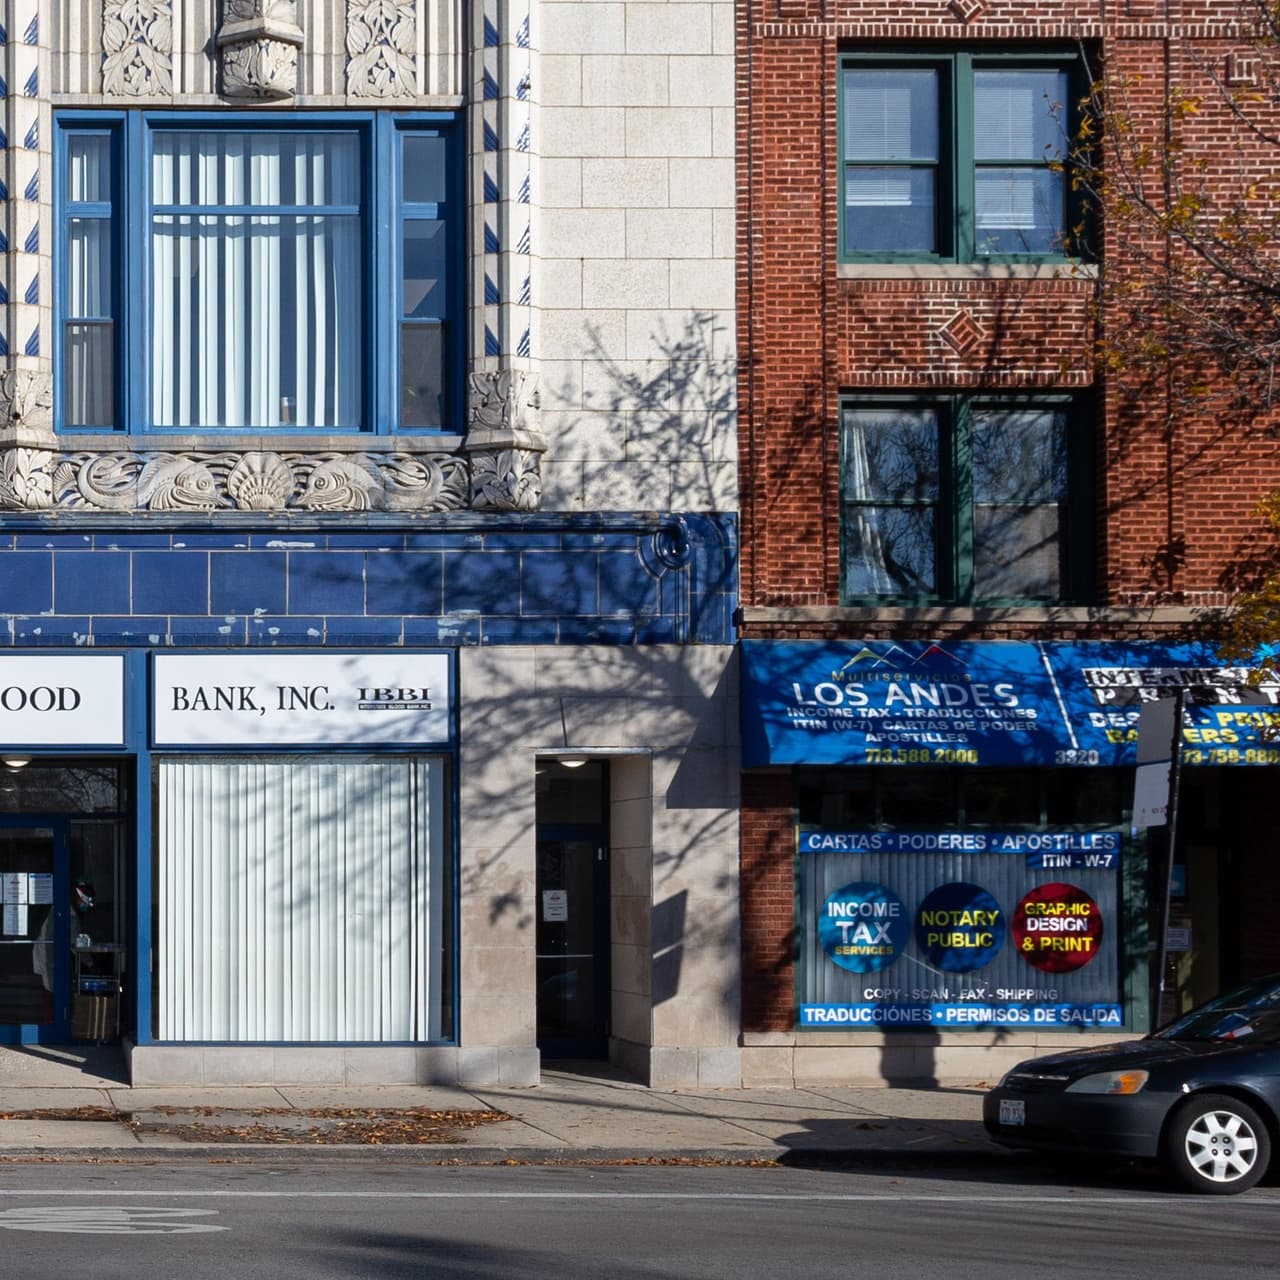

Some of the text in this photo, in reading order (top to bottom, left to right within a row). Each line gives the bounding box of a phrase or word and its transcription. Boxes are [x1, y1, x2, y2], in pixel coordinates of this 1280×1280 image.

[172, 686, 335, 716] BANK, INC.
[357, 687, 432, 701] IBBI
[792, 683, 1019, 707] LOS ANDES
[787, 708, 1038, 719] INCOME TAX TRADUCCIONES
[793, 720, 1038, 731] ITIN (W-7) CARTAS DE PODER
[865, 733, 969, 743] APOSTILLES
[1106, 729, 1239, 743] BAERS
[865, 748, 978, 764] 773.588.2000
[1055, 750, 1099, 765] 3320
[808, 834, 1116, 849] CARTAS PODERES APOSTILLES
[1043, 855, 1113, 867] ITIN W-7
[828, 902, 901, 917] INCOME
[1025, 903, 1091, 915] GRAPHIC
[922, 910, 1000, 926] NOTARY
[1027, 917, 1088, 931] DESIGN
[836, 921, 892, 944] TAX
[927, 933, 993, 948] PUBLIC
[1022, 937, 1093, 952] & PRINT
[835, 946, 894, 955] SERVICES
[863, 988, 1058, 1000] COPY SCAN FAX SHIPPING
[946, 1008, 1030, 1021] PERMISOS
[1034, 1008, 1056, 1021] DE
[1061, 1008, 1120, 1022] SALIDA
